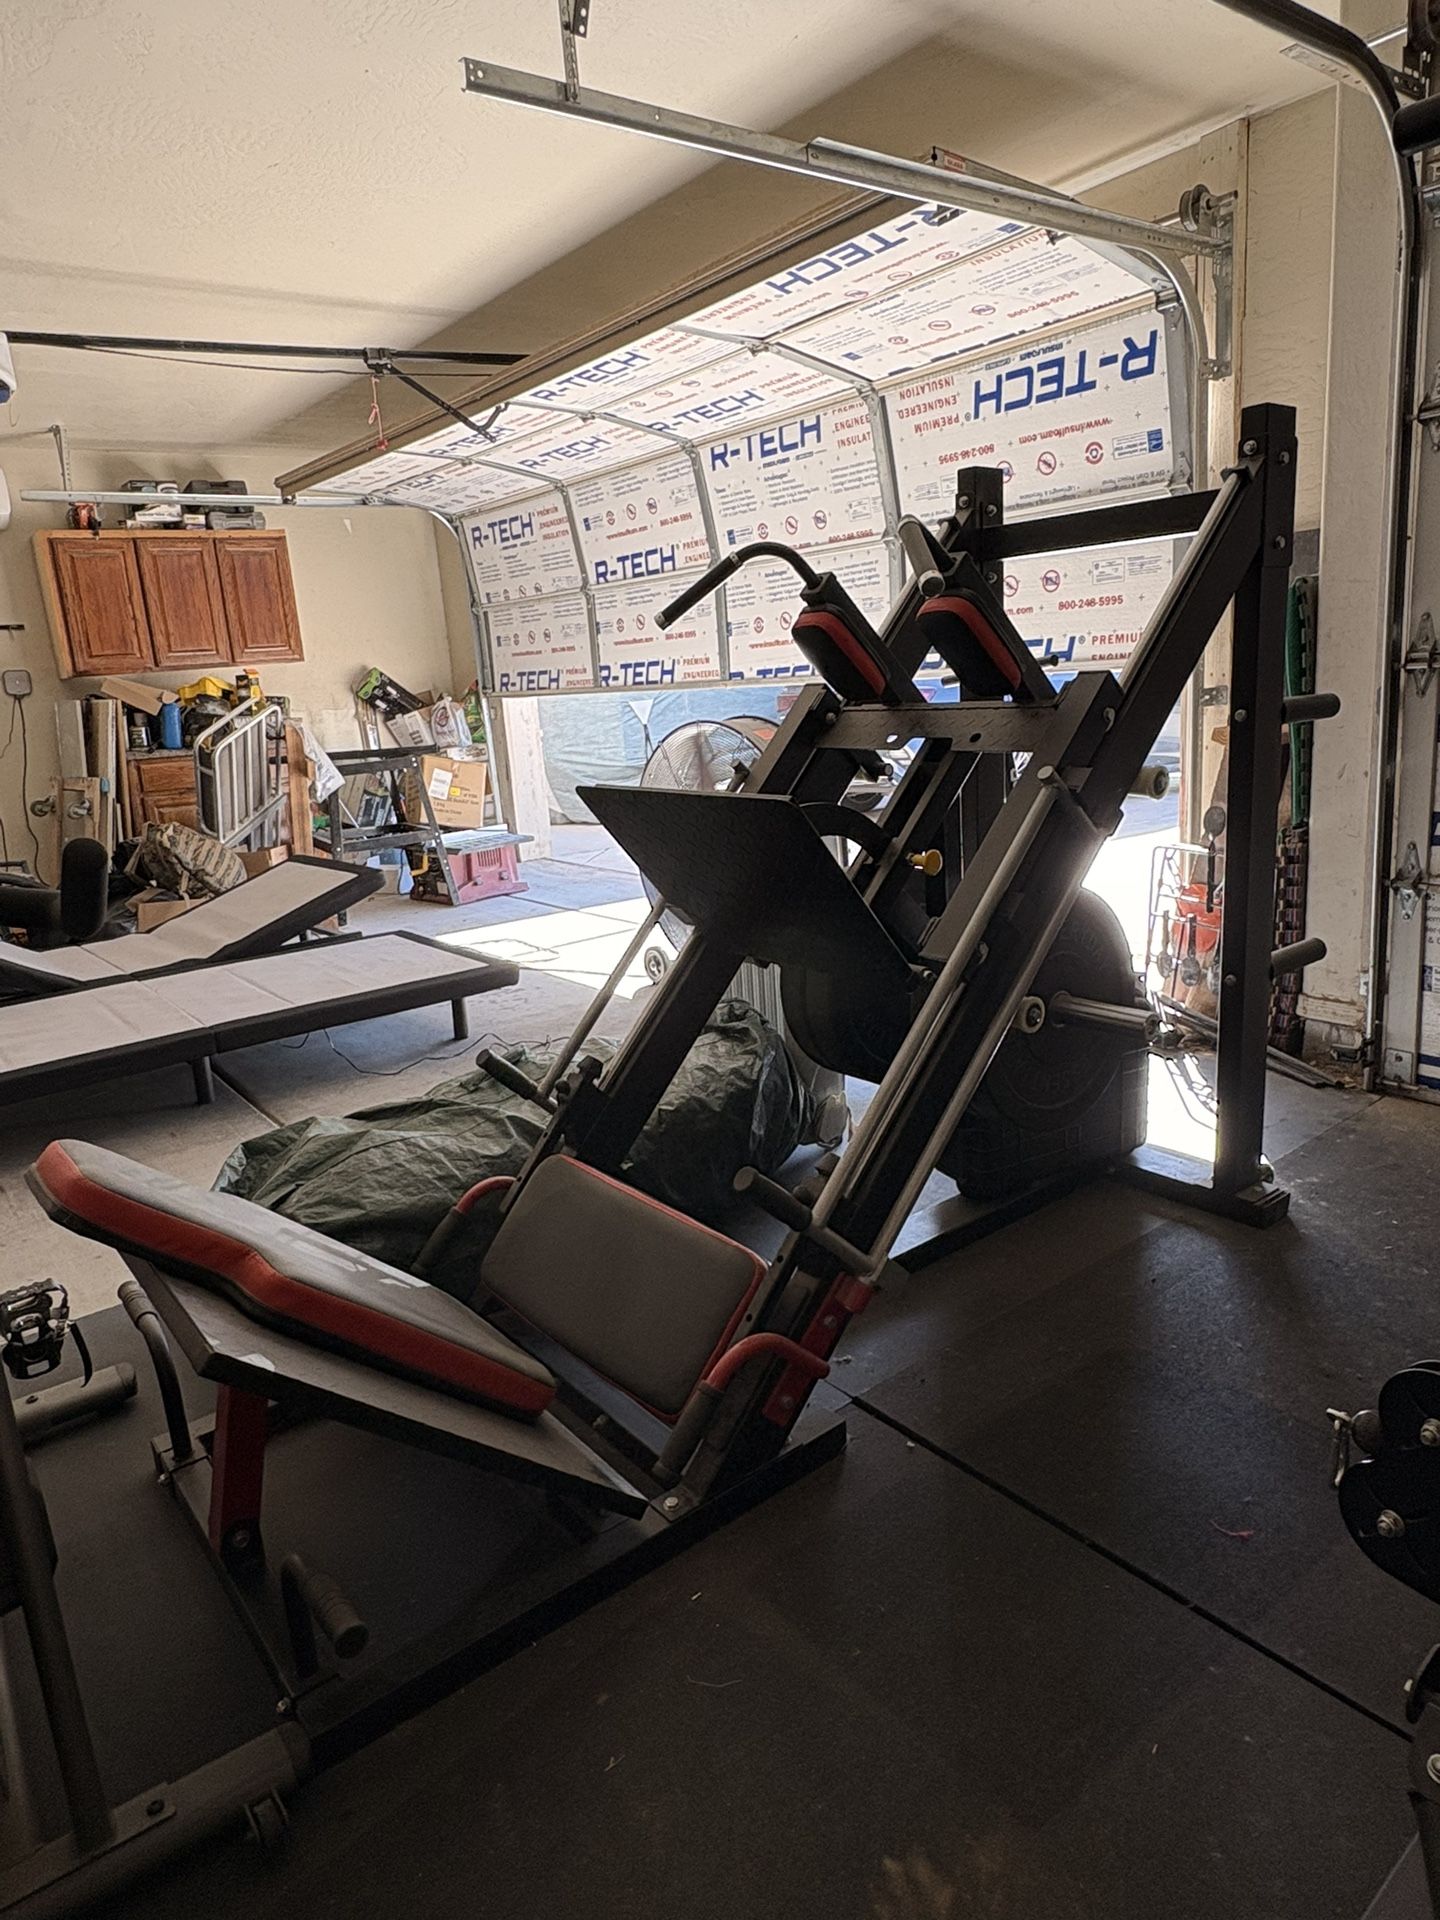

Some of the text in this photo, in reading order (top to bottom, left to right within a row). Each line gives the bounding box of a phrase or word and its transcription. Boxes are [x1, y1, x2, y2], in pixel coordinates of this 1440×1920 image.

[899, 375, 955, 400] INSULATION
[973, 329, 1158, 420] R-TECH
[897, 394, 957, 419] ENGINEERED
[914, 412, 960, 433] PREMIUM
[1018, 417, 1110, 444] www.insulfoam.com
[710, 413, 821, 472] R-TECH
[471, 511, 535, 551] R-TECH
[594, 543, 677, 585] R-TECH
[1058, 594, 1124, 611] 800-248-5995
[500, 669, 560, 692] R-TECH
[599, 658, 675, 688] R-TECH
